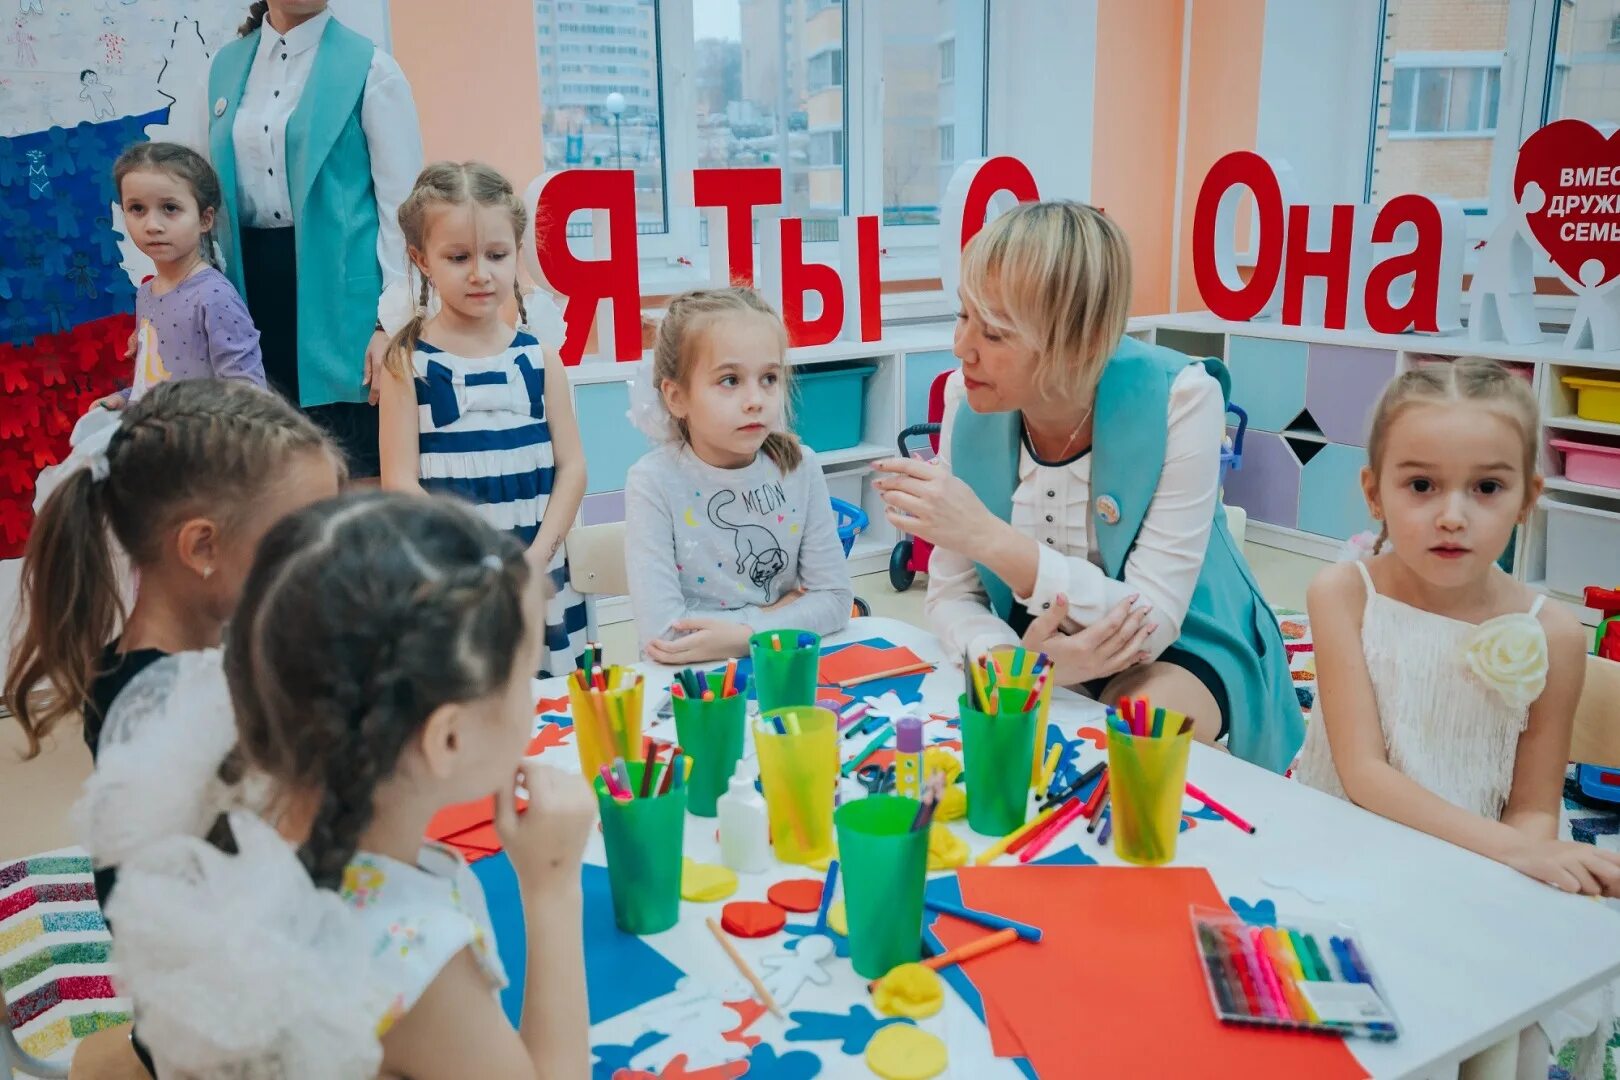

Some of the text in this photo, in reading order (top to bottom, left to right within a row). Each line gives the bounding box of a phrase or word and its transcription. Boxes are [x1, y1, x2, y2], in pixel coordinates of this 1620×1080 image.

[536, 169, 643, 367] Я
[693, 168, 882, 348] Ты
[1193, 151, 1443, 335] Она
[1547, 194, 1620, 218] ДРУЖ
